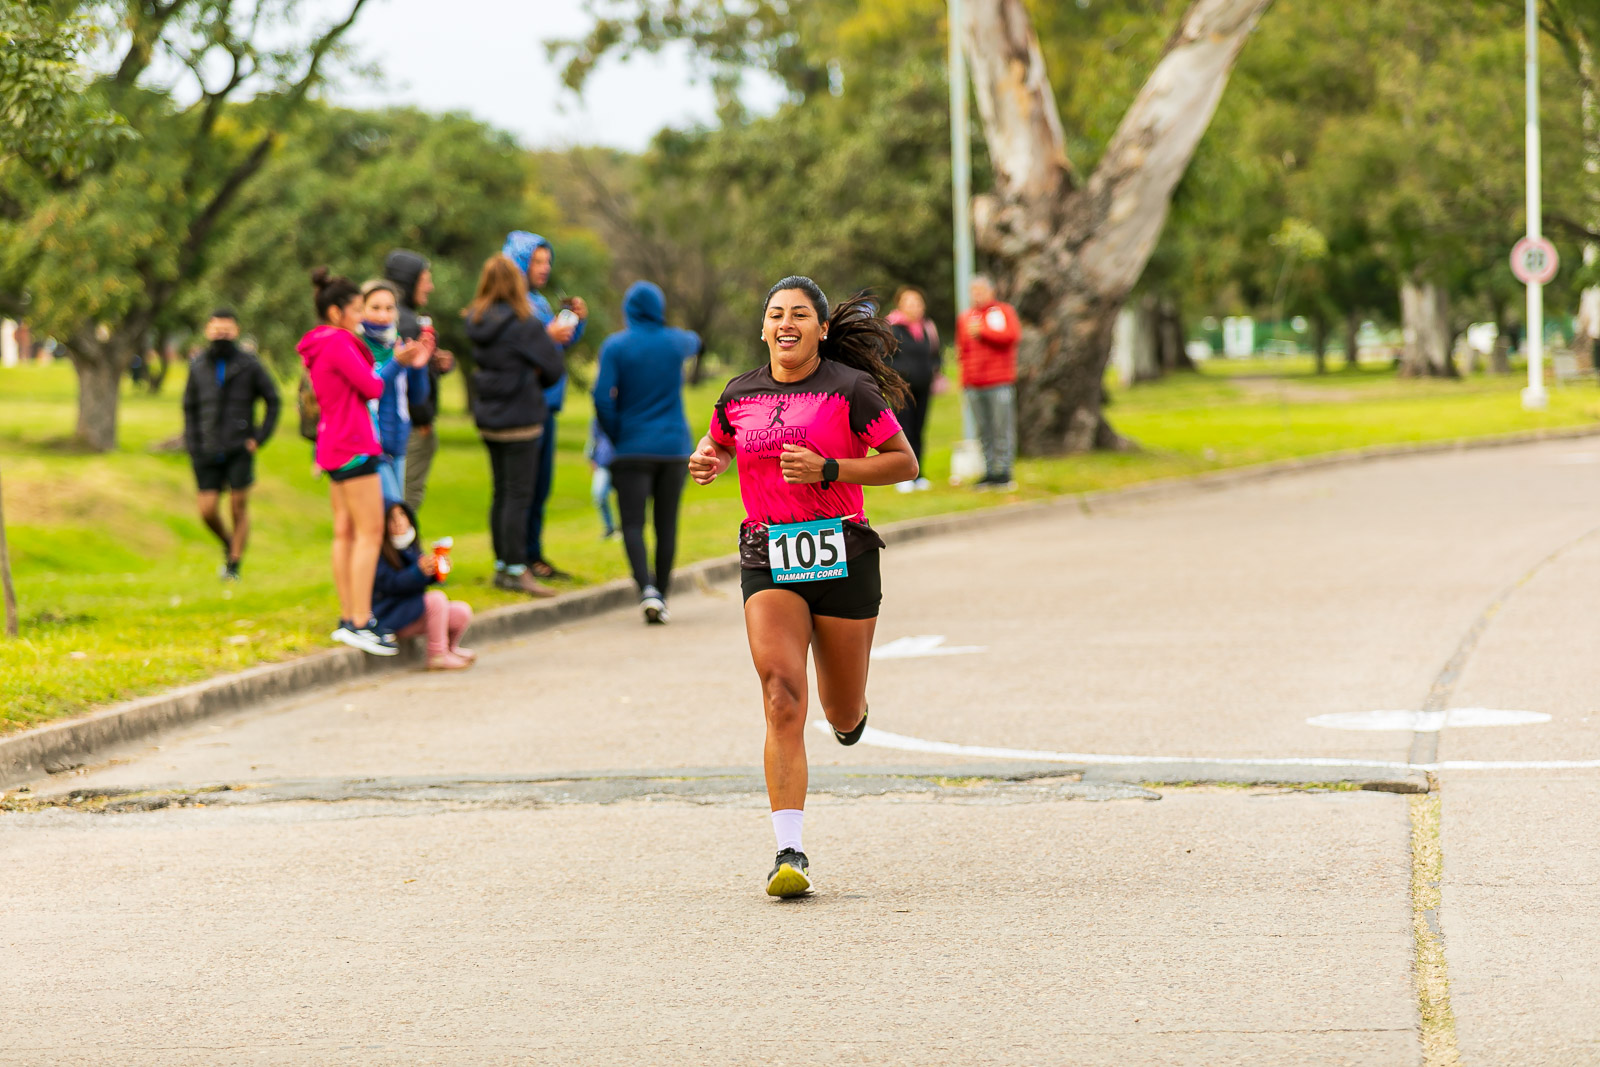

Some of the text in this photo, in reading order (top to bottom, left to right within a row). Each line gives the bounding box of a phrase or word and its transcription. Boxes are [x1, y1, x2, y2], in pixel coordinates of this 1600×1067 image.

[745, 428, 807, 442] WOMAN
[775, 528, 838, 570] 105
[776, 568, 844, 582] DIAMANTE CORRE
